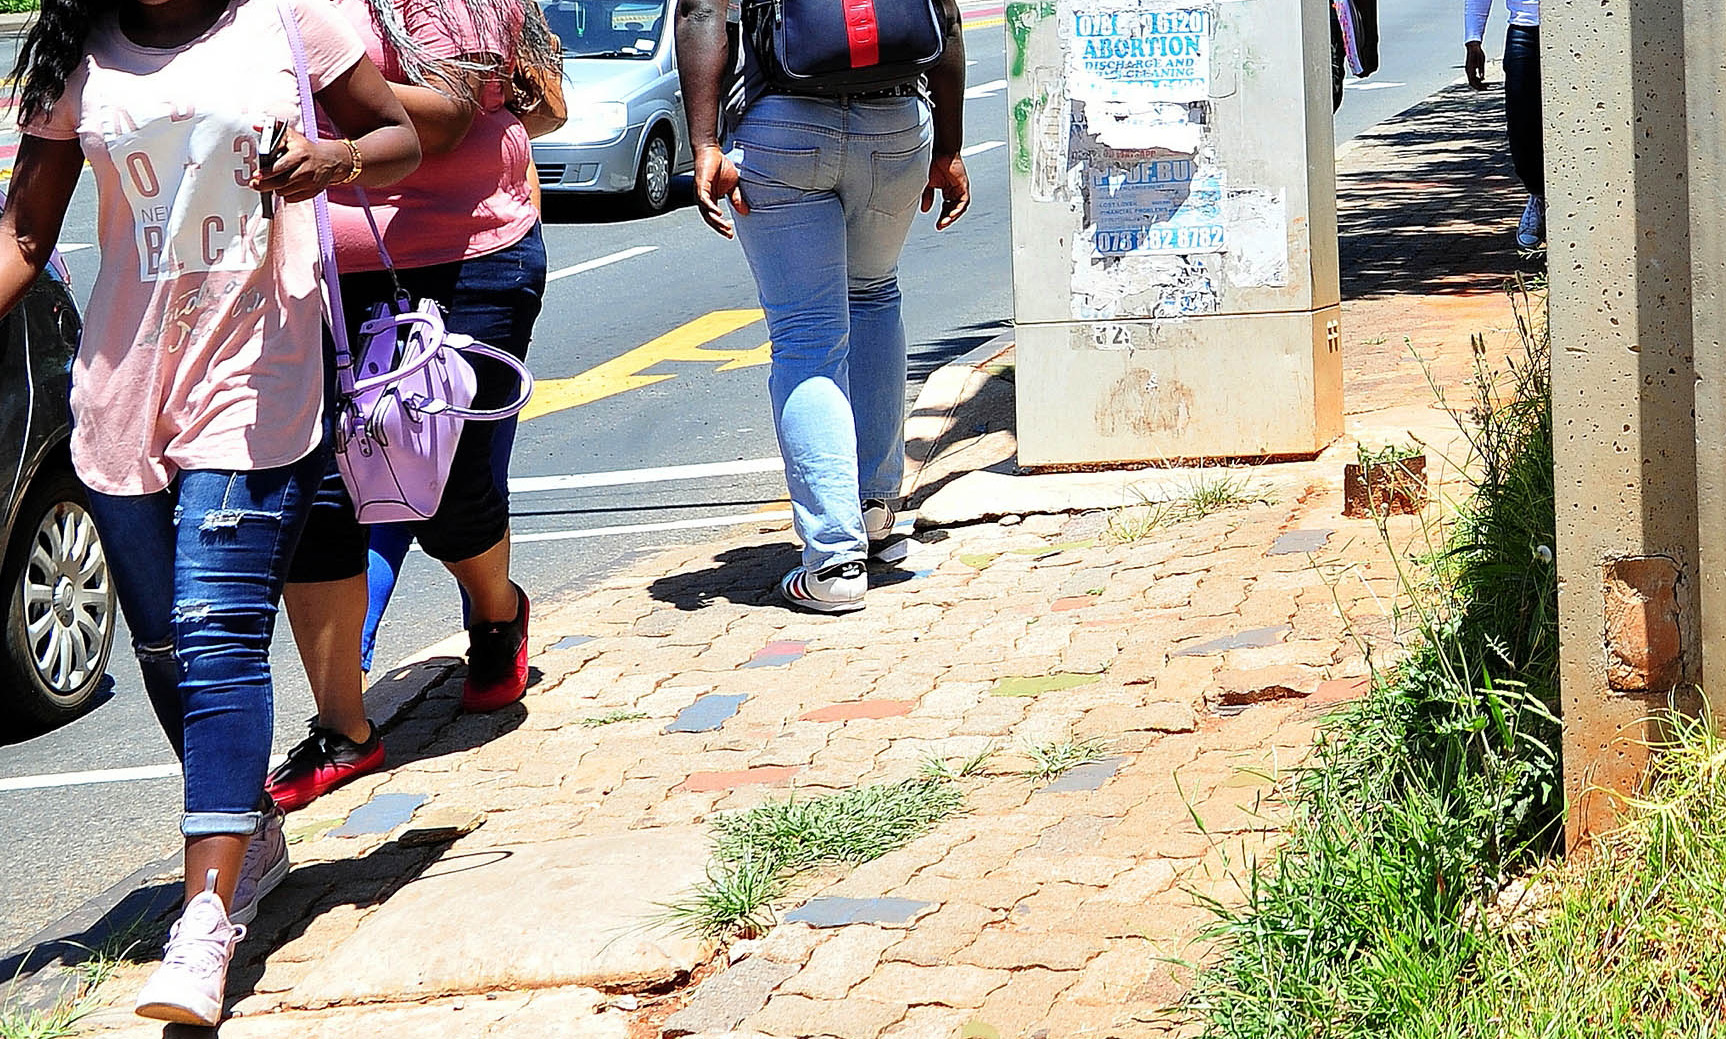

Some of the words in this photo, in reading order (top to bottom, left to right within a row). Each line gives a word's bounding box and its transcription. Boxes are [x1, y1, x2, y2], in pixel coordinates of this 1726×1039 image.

[1083, 35, 1200, 58] ABORTION
[1085, 58, 1162, 70] DISCHARGE
[1167, 58, 1194, 67] AND
[1097, 230, 1132, 252] 073
